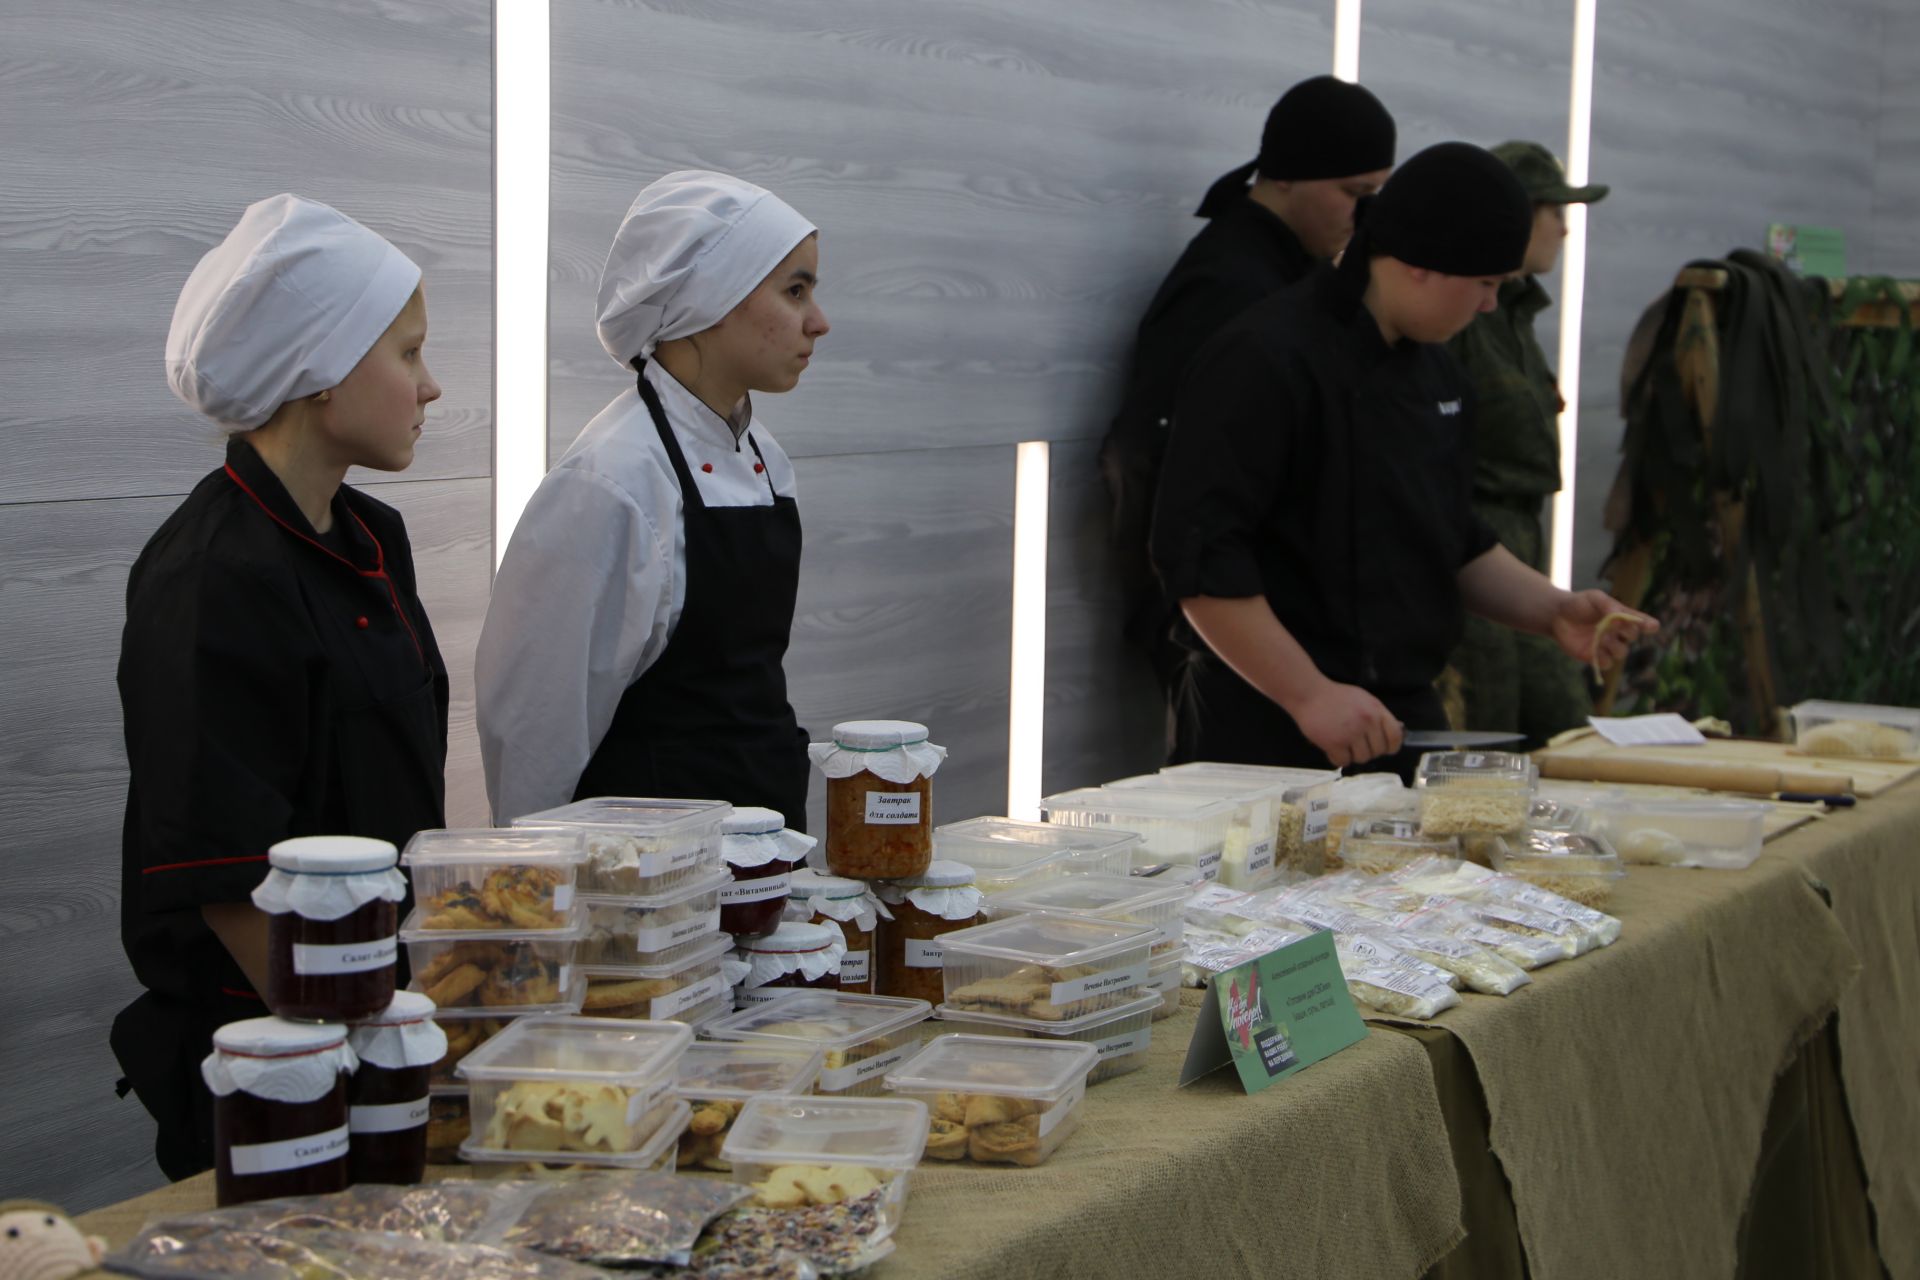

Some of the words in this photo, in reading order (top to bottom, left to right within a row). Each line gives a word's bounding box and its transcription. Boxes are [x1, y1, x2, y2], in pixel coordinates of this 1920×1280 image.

[877, 795, 912, 806] Завтрак
[869, 810, 884, 819] для
[885, 811, 919, 820] солдата
[920, 949, 943, 958] Завтр
[839, 959, 864, 968] автрак
